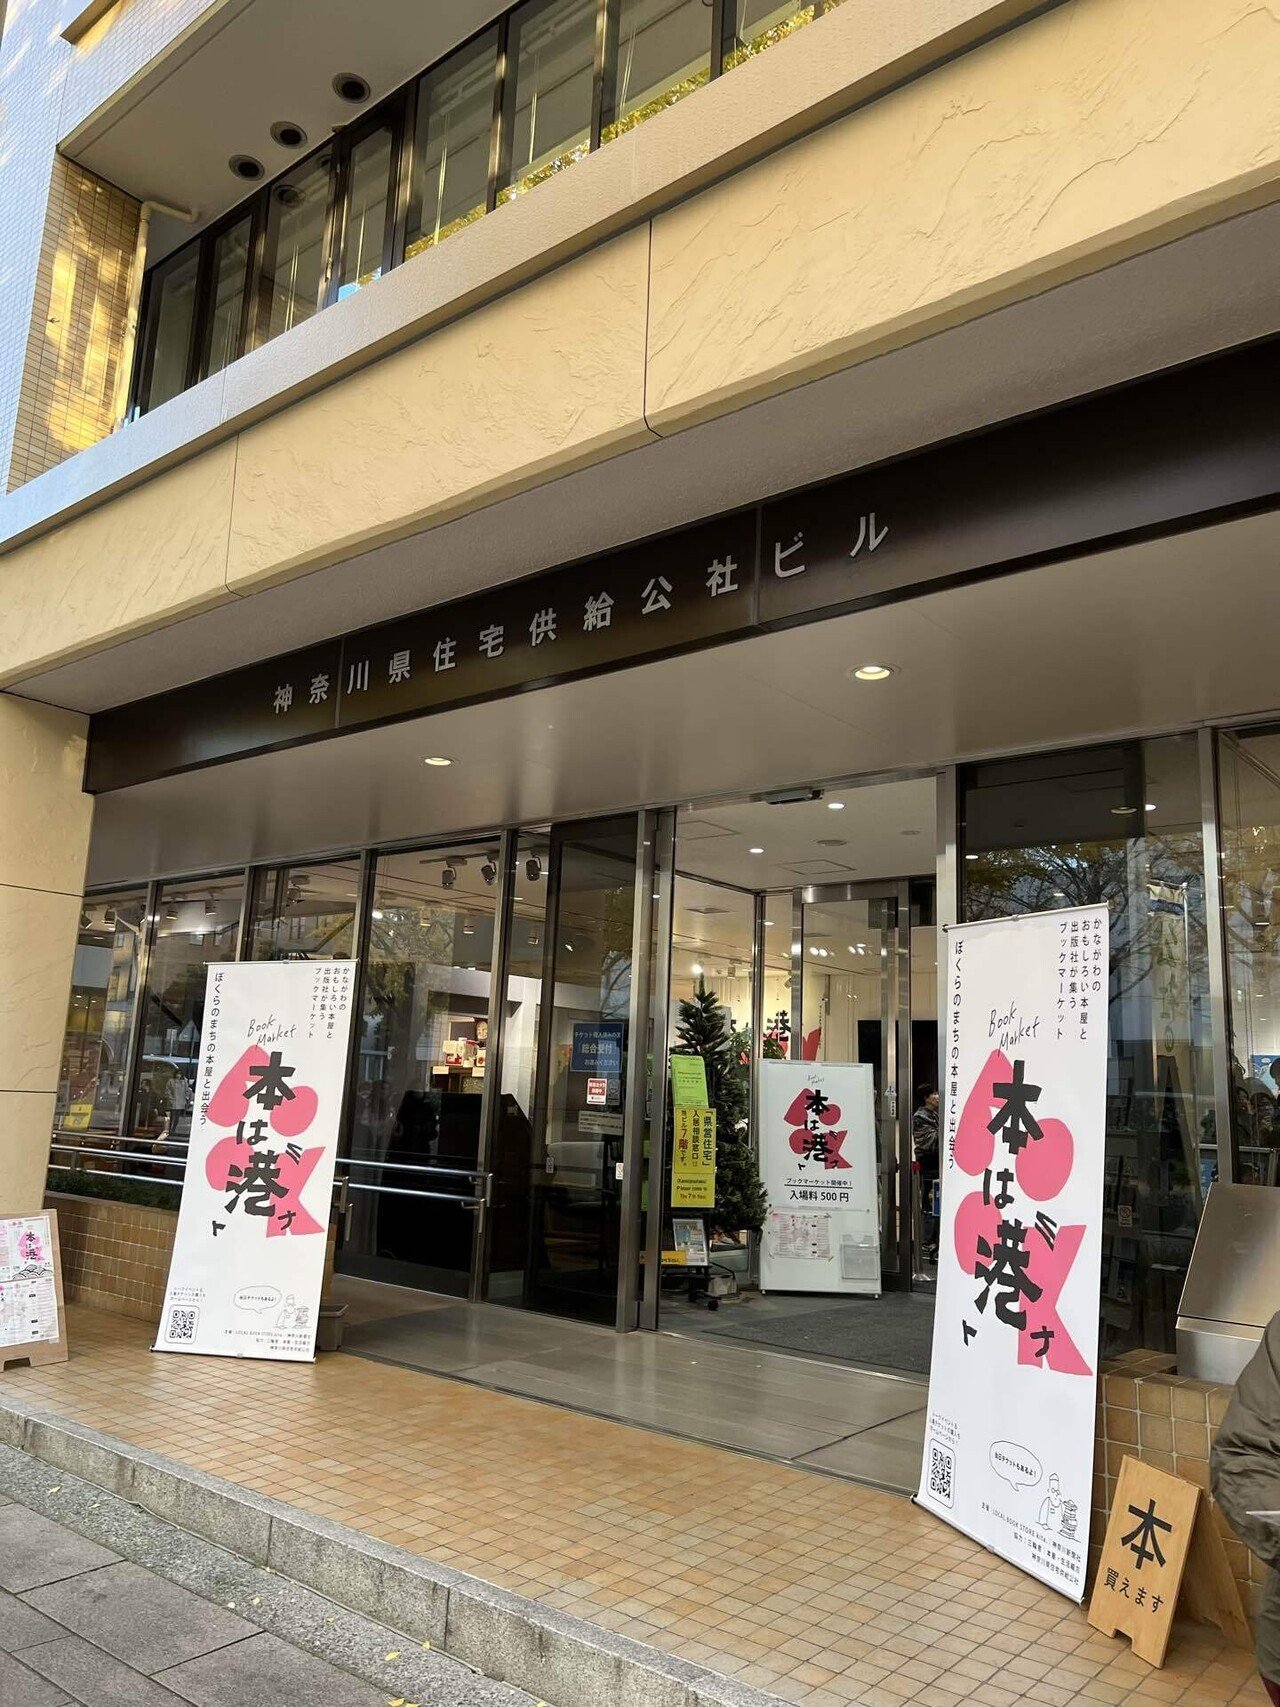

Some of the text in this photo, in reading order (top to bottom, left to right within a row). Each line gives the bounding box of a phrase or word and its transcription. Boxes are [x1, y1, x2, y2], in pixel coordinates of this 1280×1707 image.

[272, 512, 889, 715] 神奈川県住宅供給公社ビル
[338, 966, 351, 1011] かながわの
[1057, 923, 1069, 1039] ブックマーケット
[1069, 921, 1079, 1009] 出版社が集う
[1080, 920, 1091, 1040] おもしろい本屋と
[1092, 919, 1103, 992] かながわの
[247, 1014, 276, 1038] Book
[308, 968, 322, 1038] ブックマーケット
[318, 967, 331, 1021] 出版社が集う
[326, 967, 341, 1039] おもしろい本屋と
[988, 1000, 1017, 1037] Book
[200, 972, 224, 1125] ぼくらのまちの本屋と出会う
[254, 1024, 298, 1050] Market
[948, 941, 964, 1169] ぼくらのまちの本屋と出会う
[997, 1016, 1040, 1057] Market
[224, 1051, 296, 1217] 本は港
[802, 1089, 834, 1162] 本は港
[974, 1059, 1045, 1331] 本は港
[1120, 1498, 1173, 1571] 本
[1103, 1567, 1165, 1614] 買えます
